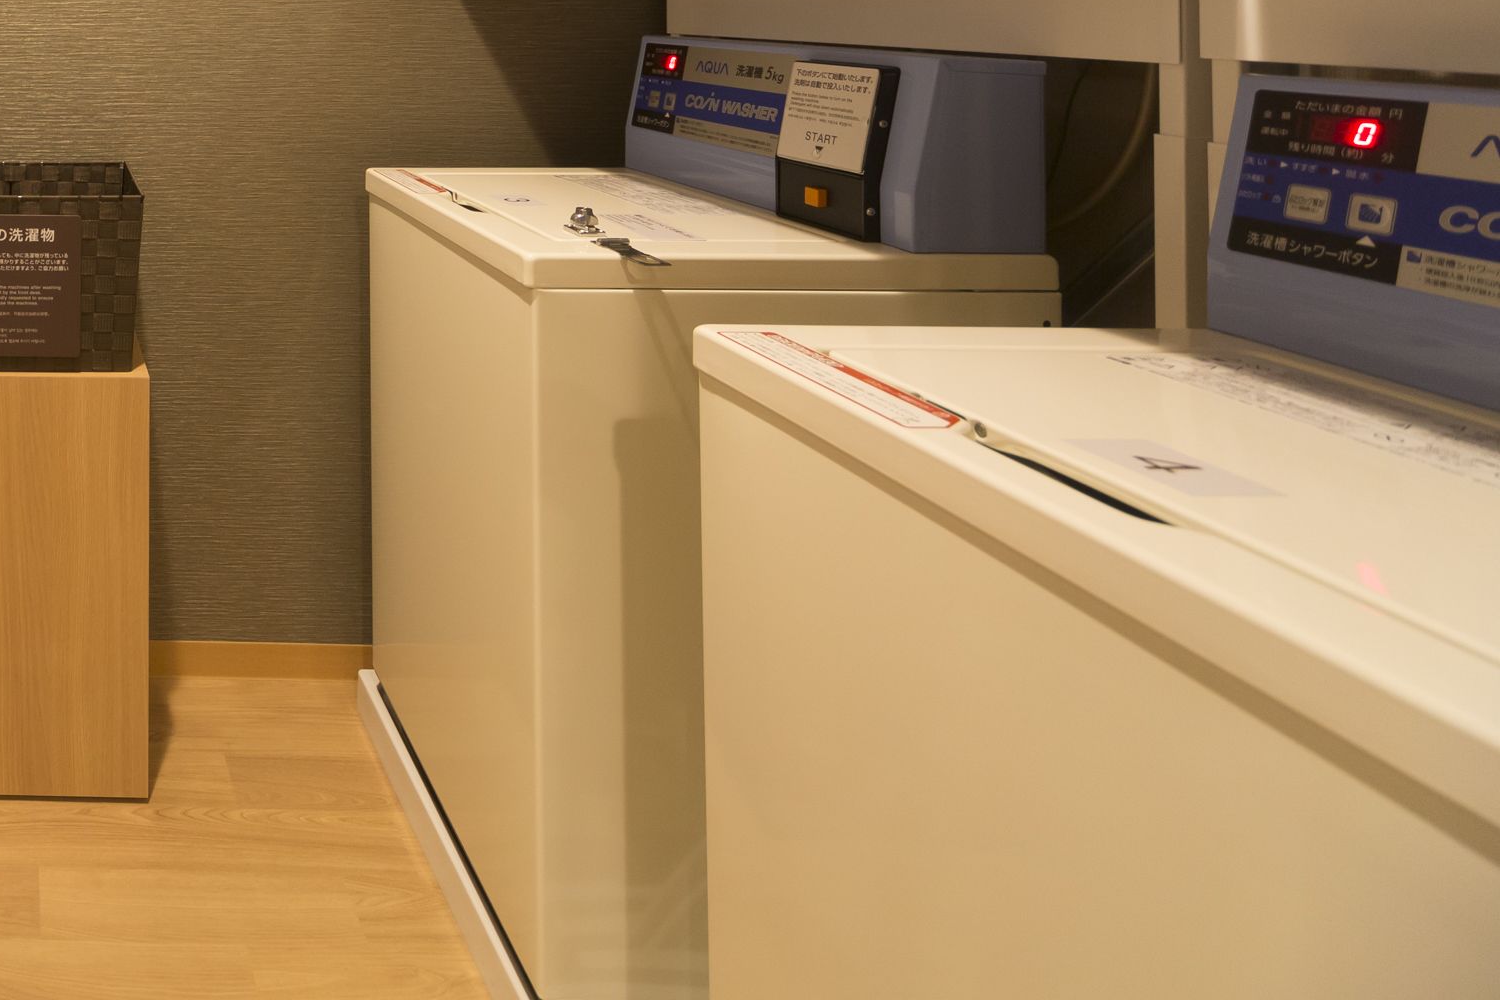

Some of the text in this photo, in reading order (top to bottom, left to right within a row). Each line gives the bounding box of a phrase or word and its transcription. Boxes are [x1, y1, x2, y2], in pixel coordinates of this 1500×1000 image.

[735, 65, 763, 79] 洗濯機
[764, 66, 784, 84] 5kg
[722, 98, 779, 123] WASHER
[1295, 100, 1403, 119] ただいまの金額 円
[804, 131, 838, 146] START
[1353, 122, 1377, 146] 0
[1381, 152, 1395, 164] 分
[1246, 231, 1380, 269] 洗濯槽シャワーボタン
[1132, 453, 1204, 474] 4
